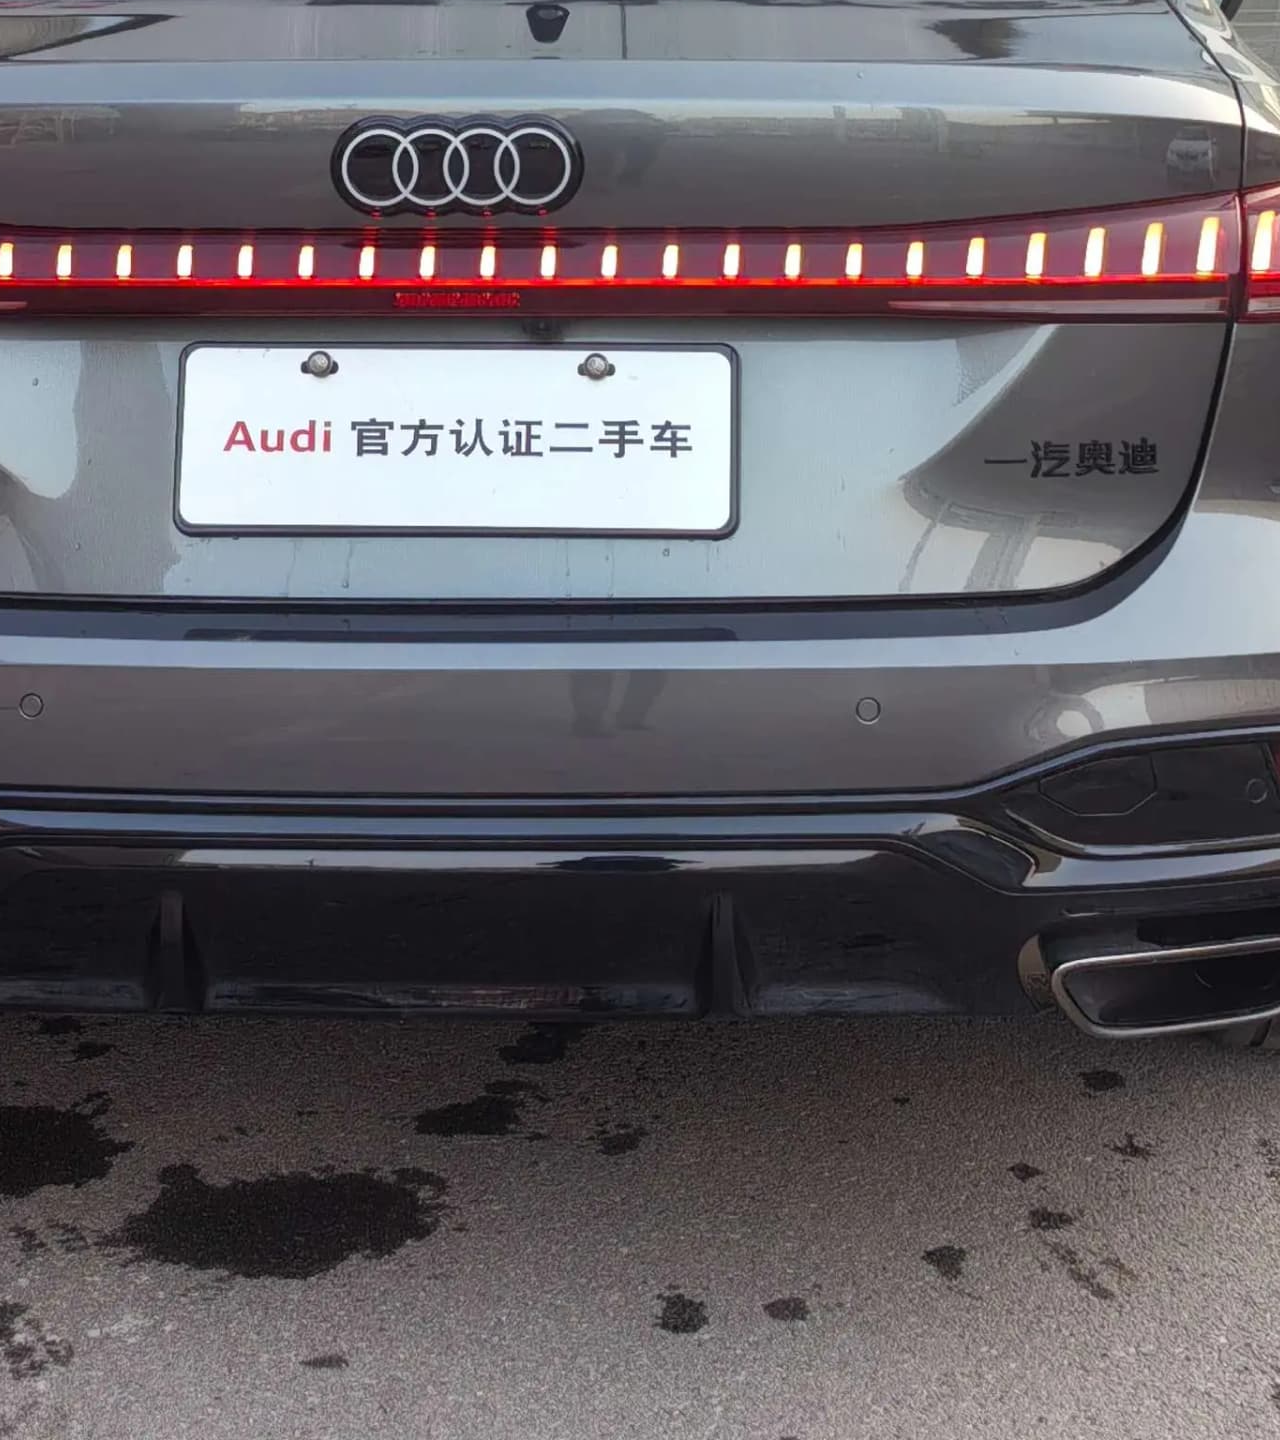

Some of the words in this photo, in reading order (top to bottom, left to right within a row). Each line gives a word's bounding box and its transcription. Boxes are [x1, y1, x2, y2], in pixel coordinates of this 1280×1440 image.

[223, 419, 333, 453] Audi
[350, 417, 693, 458] 官方认证二手车
[983, 436, 1159, 478] 一汽奥迪
